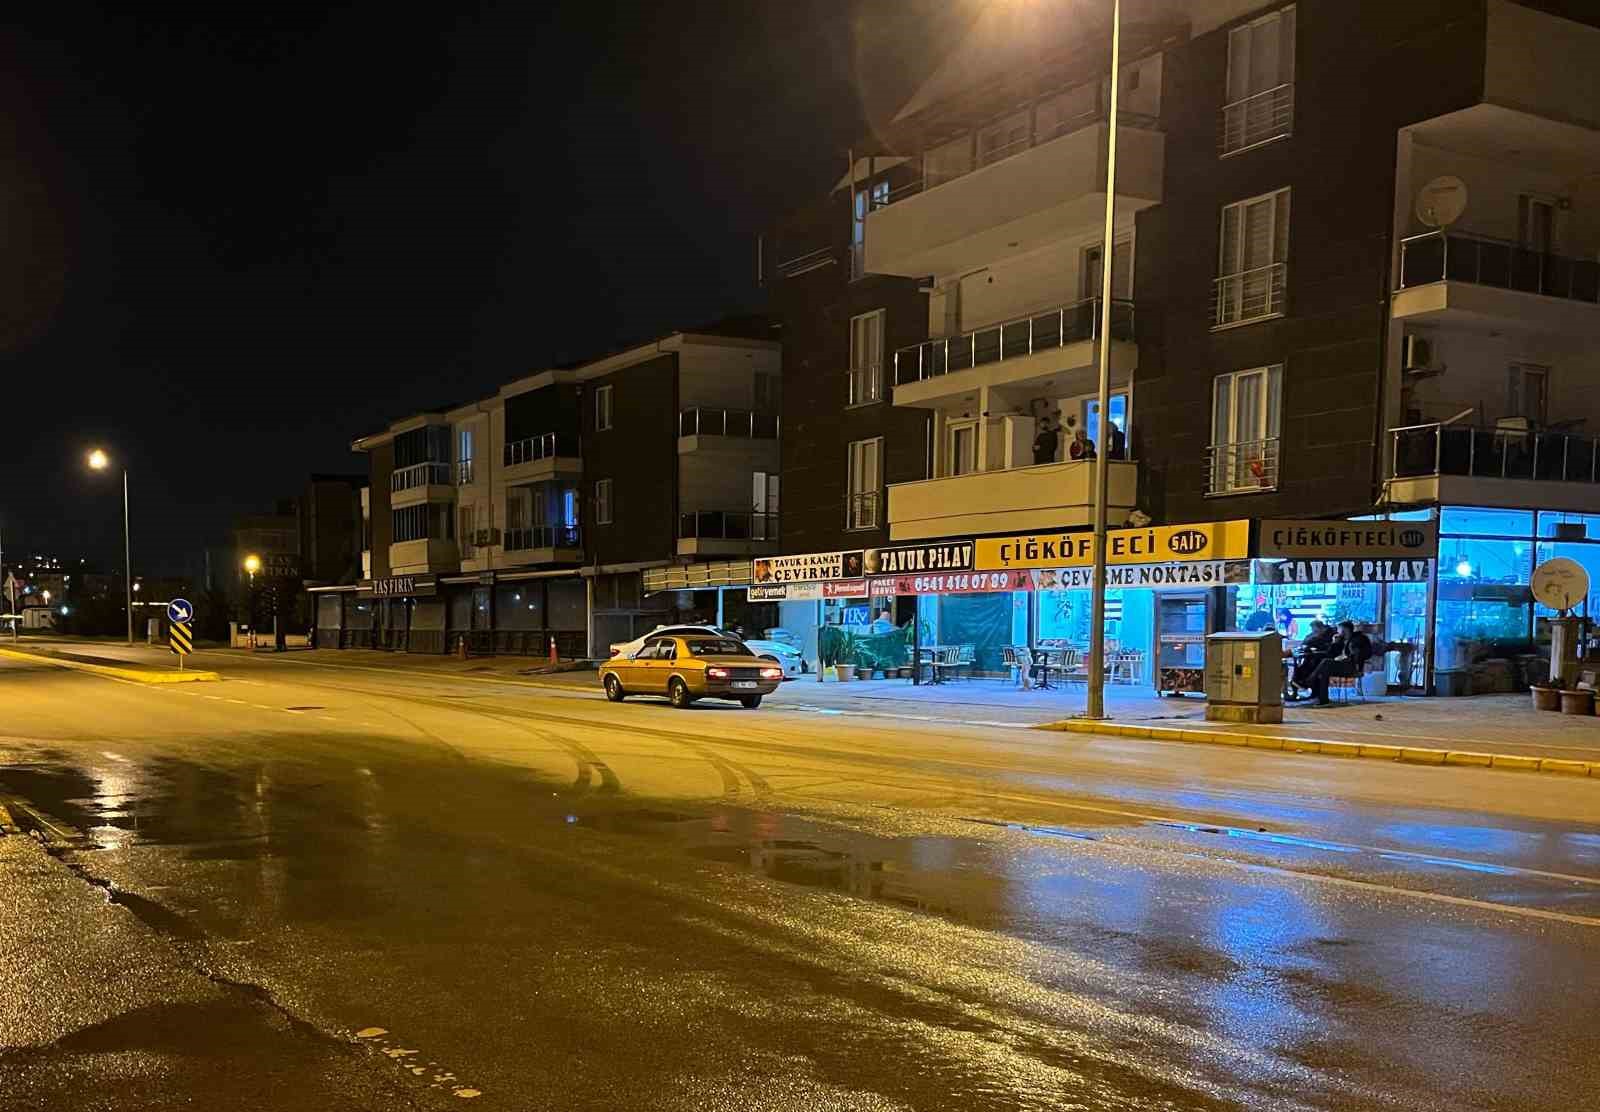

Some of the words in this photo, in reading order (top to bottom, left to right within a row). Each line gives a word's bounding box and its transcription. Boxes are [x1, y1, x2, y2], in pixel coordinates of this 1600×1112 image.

[1000, 530, 1155, 566] ÇİĞKÖFECİ
[1172, 531, 1202, 551] SAİT
[1273, 527, 1394, 549] ÇİĞKÖFTECİ
[775, 558, 801, 568] TAVUK
[810, 554, 840, 565] KANAT
[881, 549, 925, 571] TAVUK
[1061, 566, 1134, 589] ÇEVME
[1140, 563, 1220, 585] NOKTASI
[1279, 561, 1356, 581] TAVUK
[915, 575, 944, 592] 0541
[946, 574, 969, 590] 414
[971, 573, 989, 589] 07
